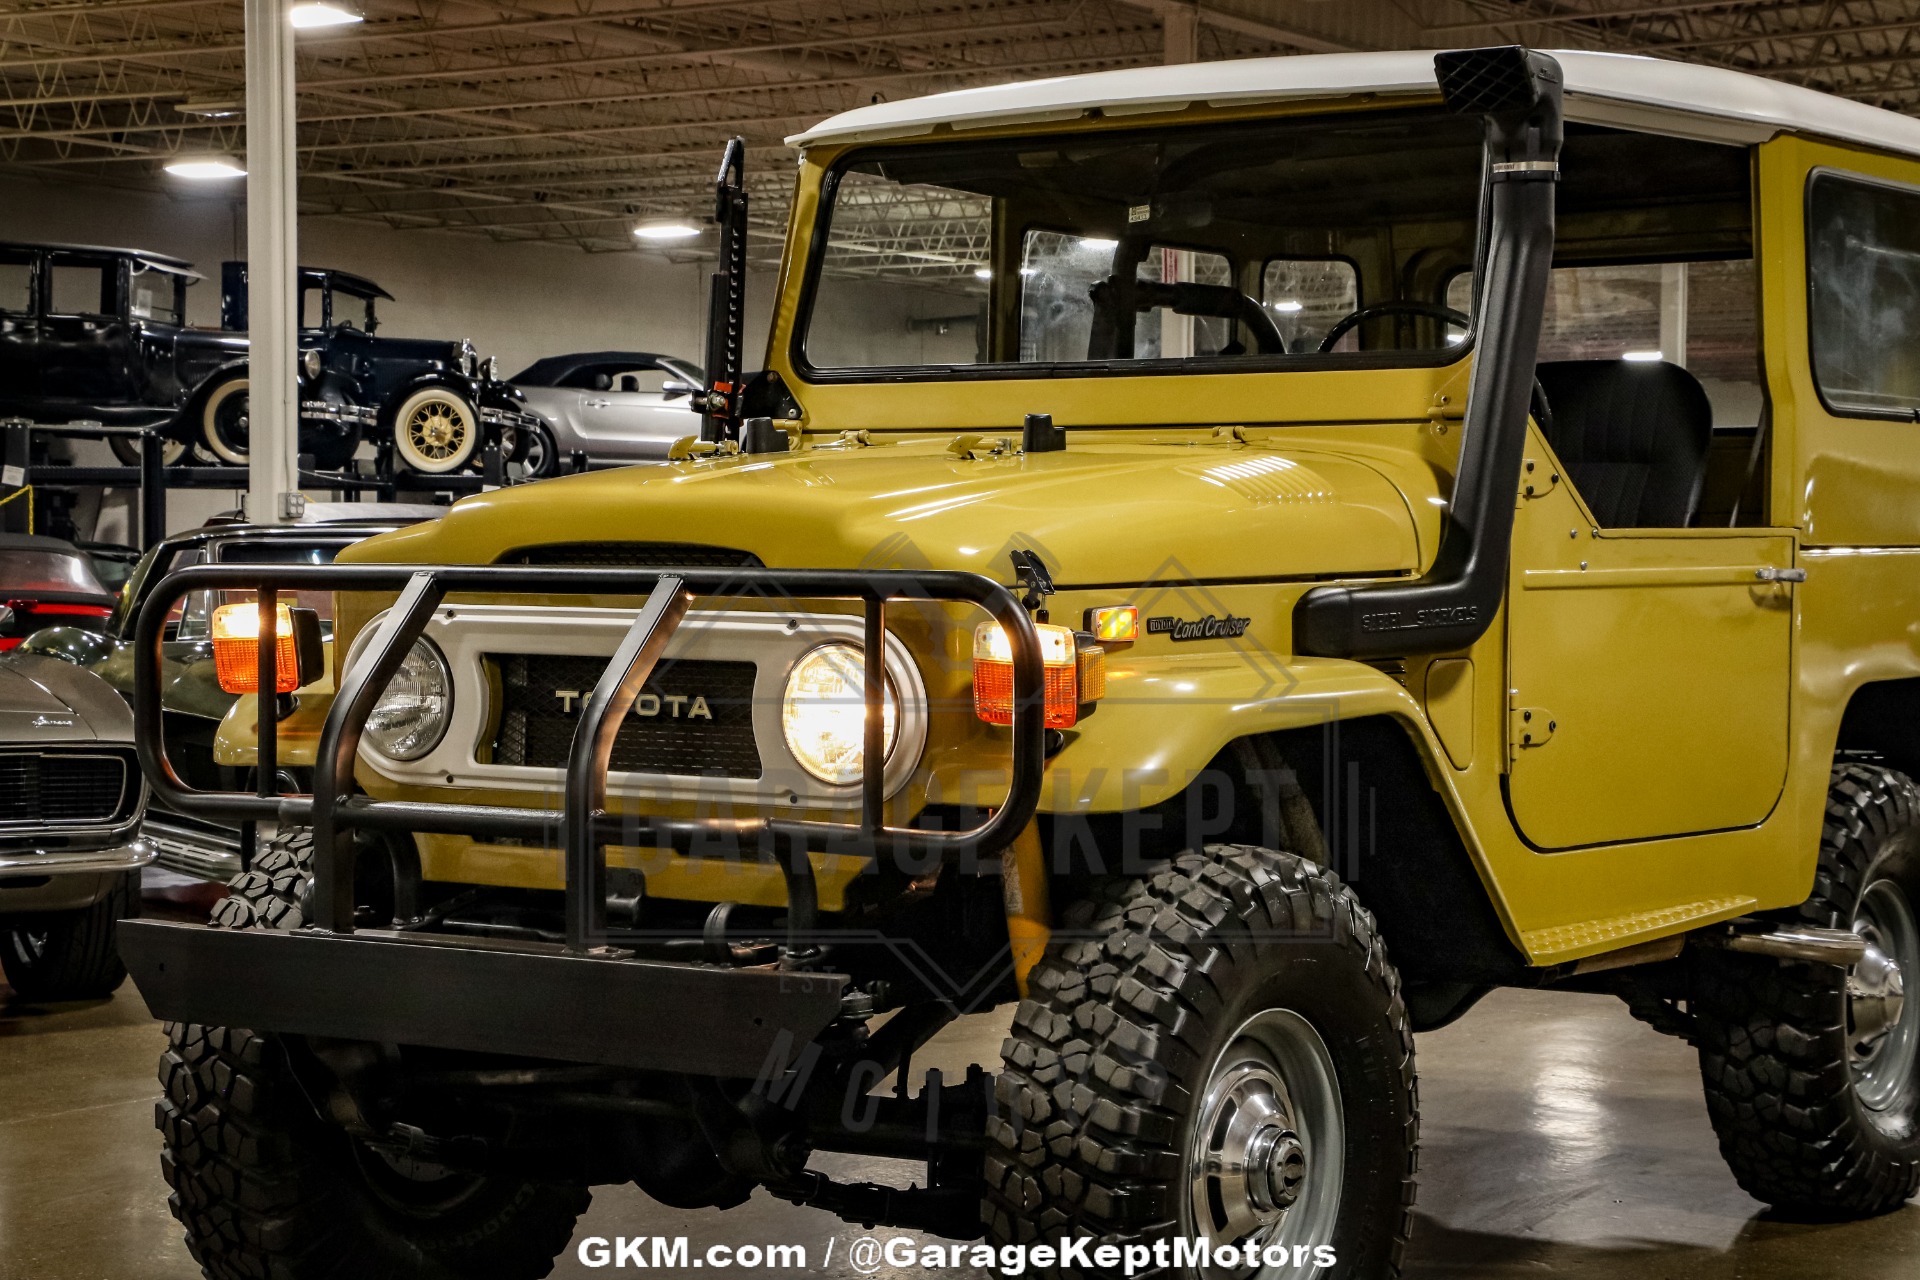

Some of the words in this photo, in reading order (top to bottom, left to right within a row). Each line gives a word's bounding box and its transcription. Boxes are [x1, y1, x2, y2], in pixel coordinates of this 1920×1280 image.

[1174, 619, 1206, 639] Land
[1205, 615, 1251, 636] Cruiser
[555, 690, 713, 720] TOTA
